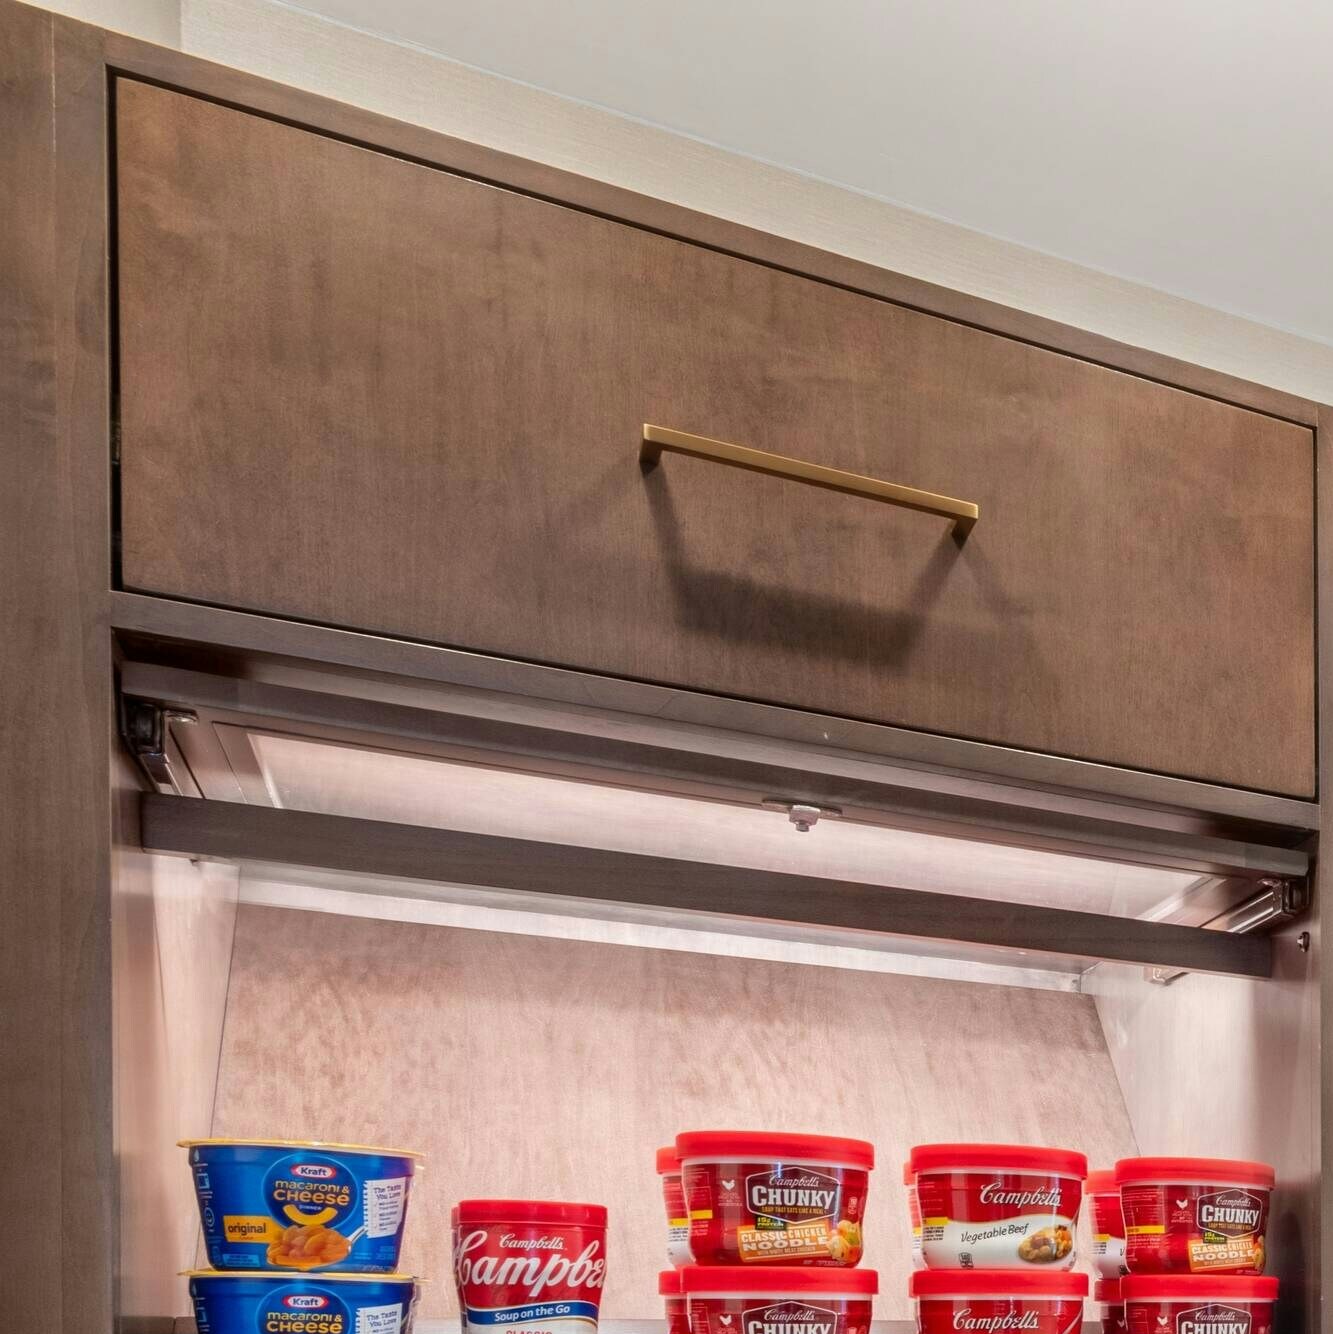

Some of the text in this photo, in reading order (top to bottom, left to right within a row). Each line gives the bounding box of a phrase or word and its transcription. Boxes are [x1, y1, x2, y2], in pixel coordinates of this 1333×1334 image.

[300, 1166, 327, 1177] Kraft
[275, 1180, 349, 1194] macaroni &
[769, 1175, 820, 1188] Campbell's
[752, 1185, 835, 1209] CHUNKY
[1202, 1204, 1259, 1225] CHUNKY
[228, 1222, 266, 1235] original
[961, 1226, 1006, 1244] Vegetable
[1008, 1223, 1030, 1235] Beef
[500, 1233, 563, 1251] Campbell's
[741, 1229, 827, 1243] CLASSIC CHICKEN
[743, 1236, 829, 1252] NOODLE
[1193, 1248, 1256, 1262] NOODLE
[293, 1298, 319, 1307] Kraft
[267, 1311, 342, 1322] macaroni &
[494, 1305, 570, 1322] Soup on the Go
[764, 1308, 815, 1321] Campbell's
[1195, 1310, 1236, 1322] Campbell's
[953, 1308, 1040, 1334] Campbell's
